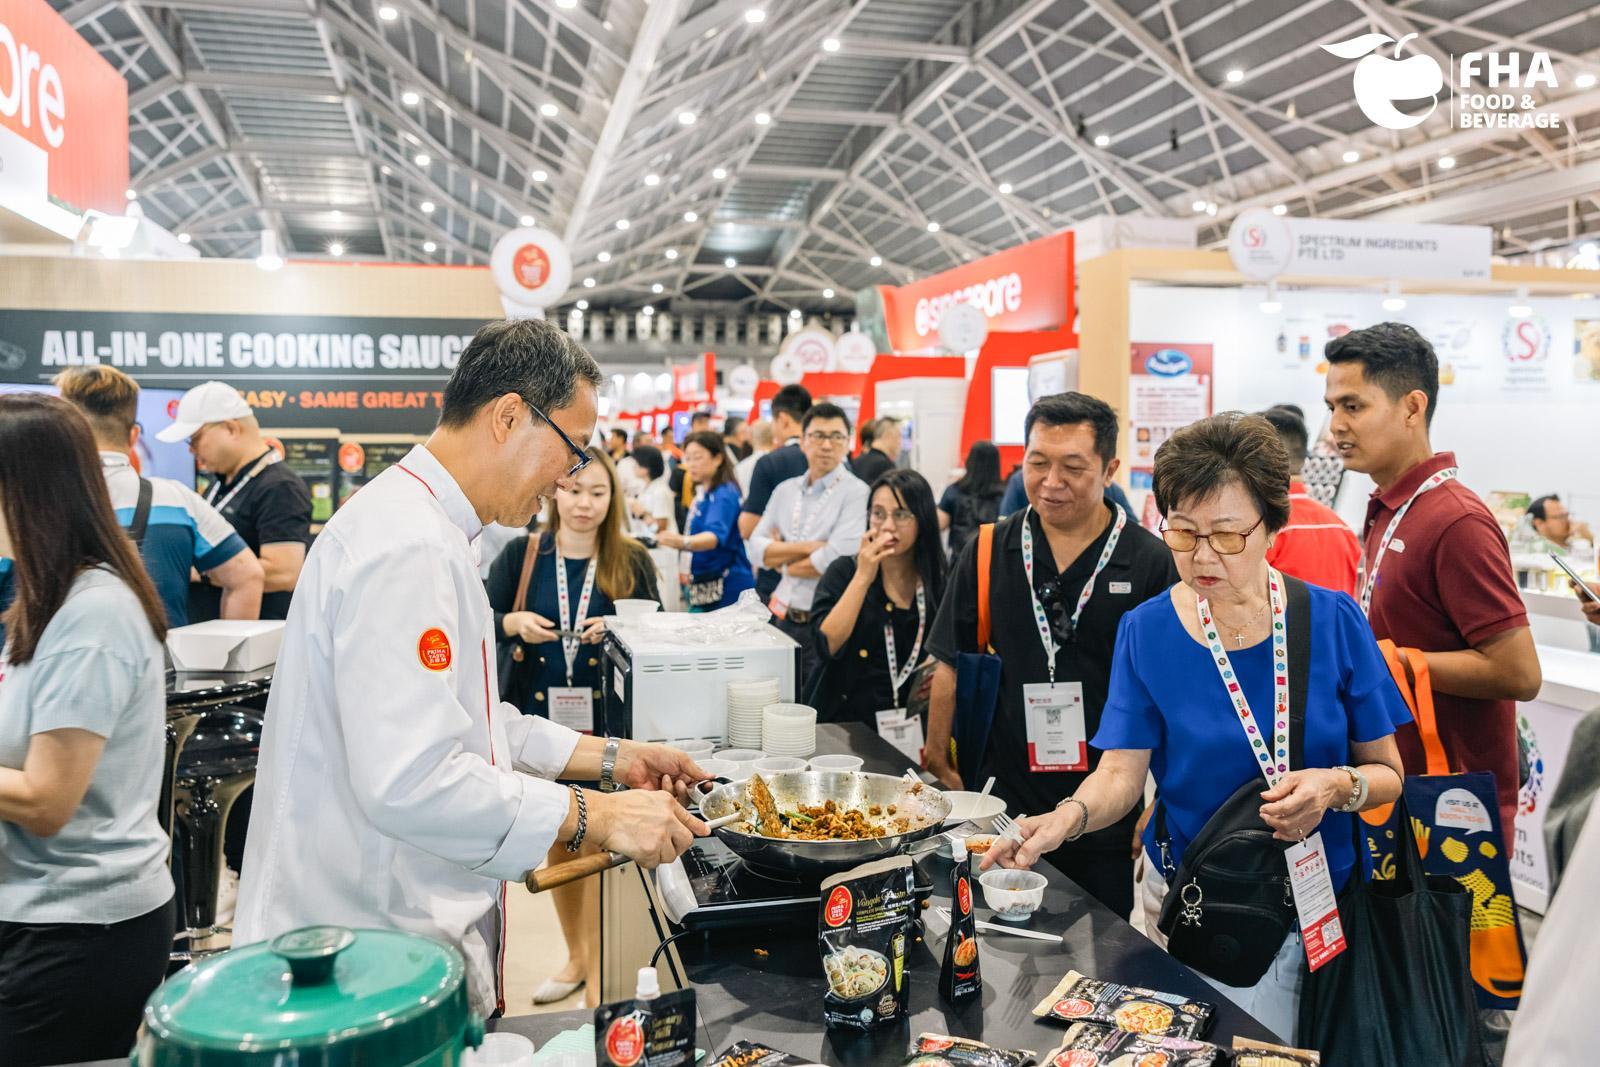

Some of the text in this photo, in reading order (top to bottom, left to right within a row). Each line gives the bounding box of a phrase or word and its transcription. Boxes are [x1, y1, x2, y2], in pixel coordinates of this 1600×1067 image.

[1298, 235, 1438, 252] SPECTRUM INGREDIENTS
[1298, 247, 1345, 261] PTE LTD
[41, 330, 475, 370] ALL-IN-ONE COOKING SAUC
[240, 390, 287, 409] ASY
[299, 391, 358, 409] SAME
[362, 392, 428, 410] GREAT
